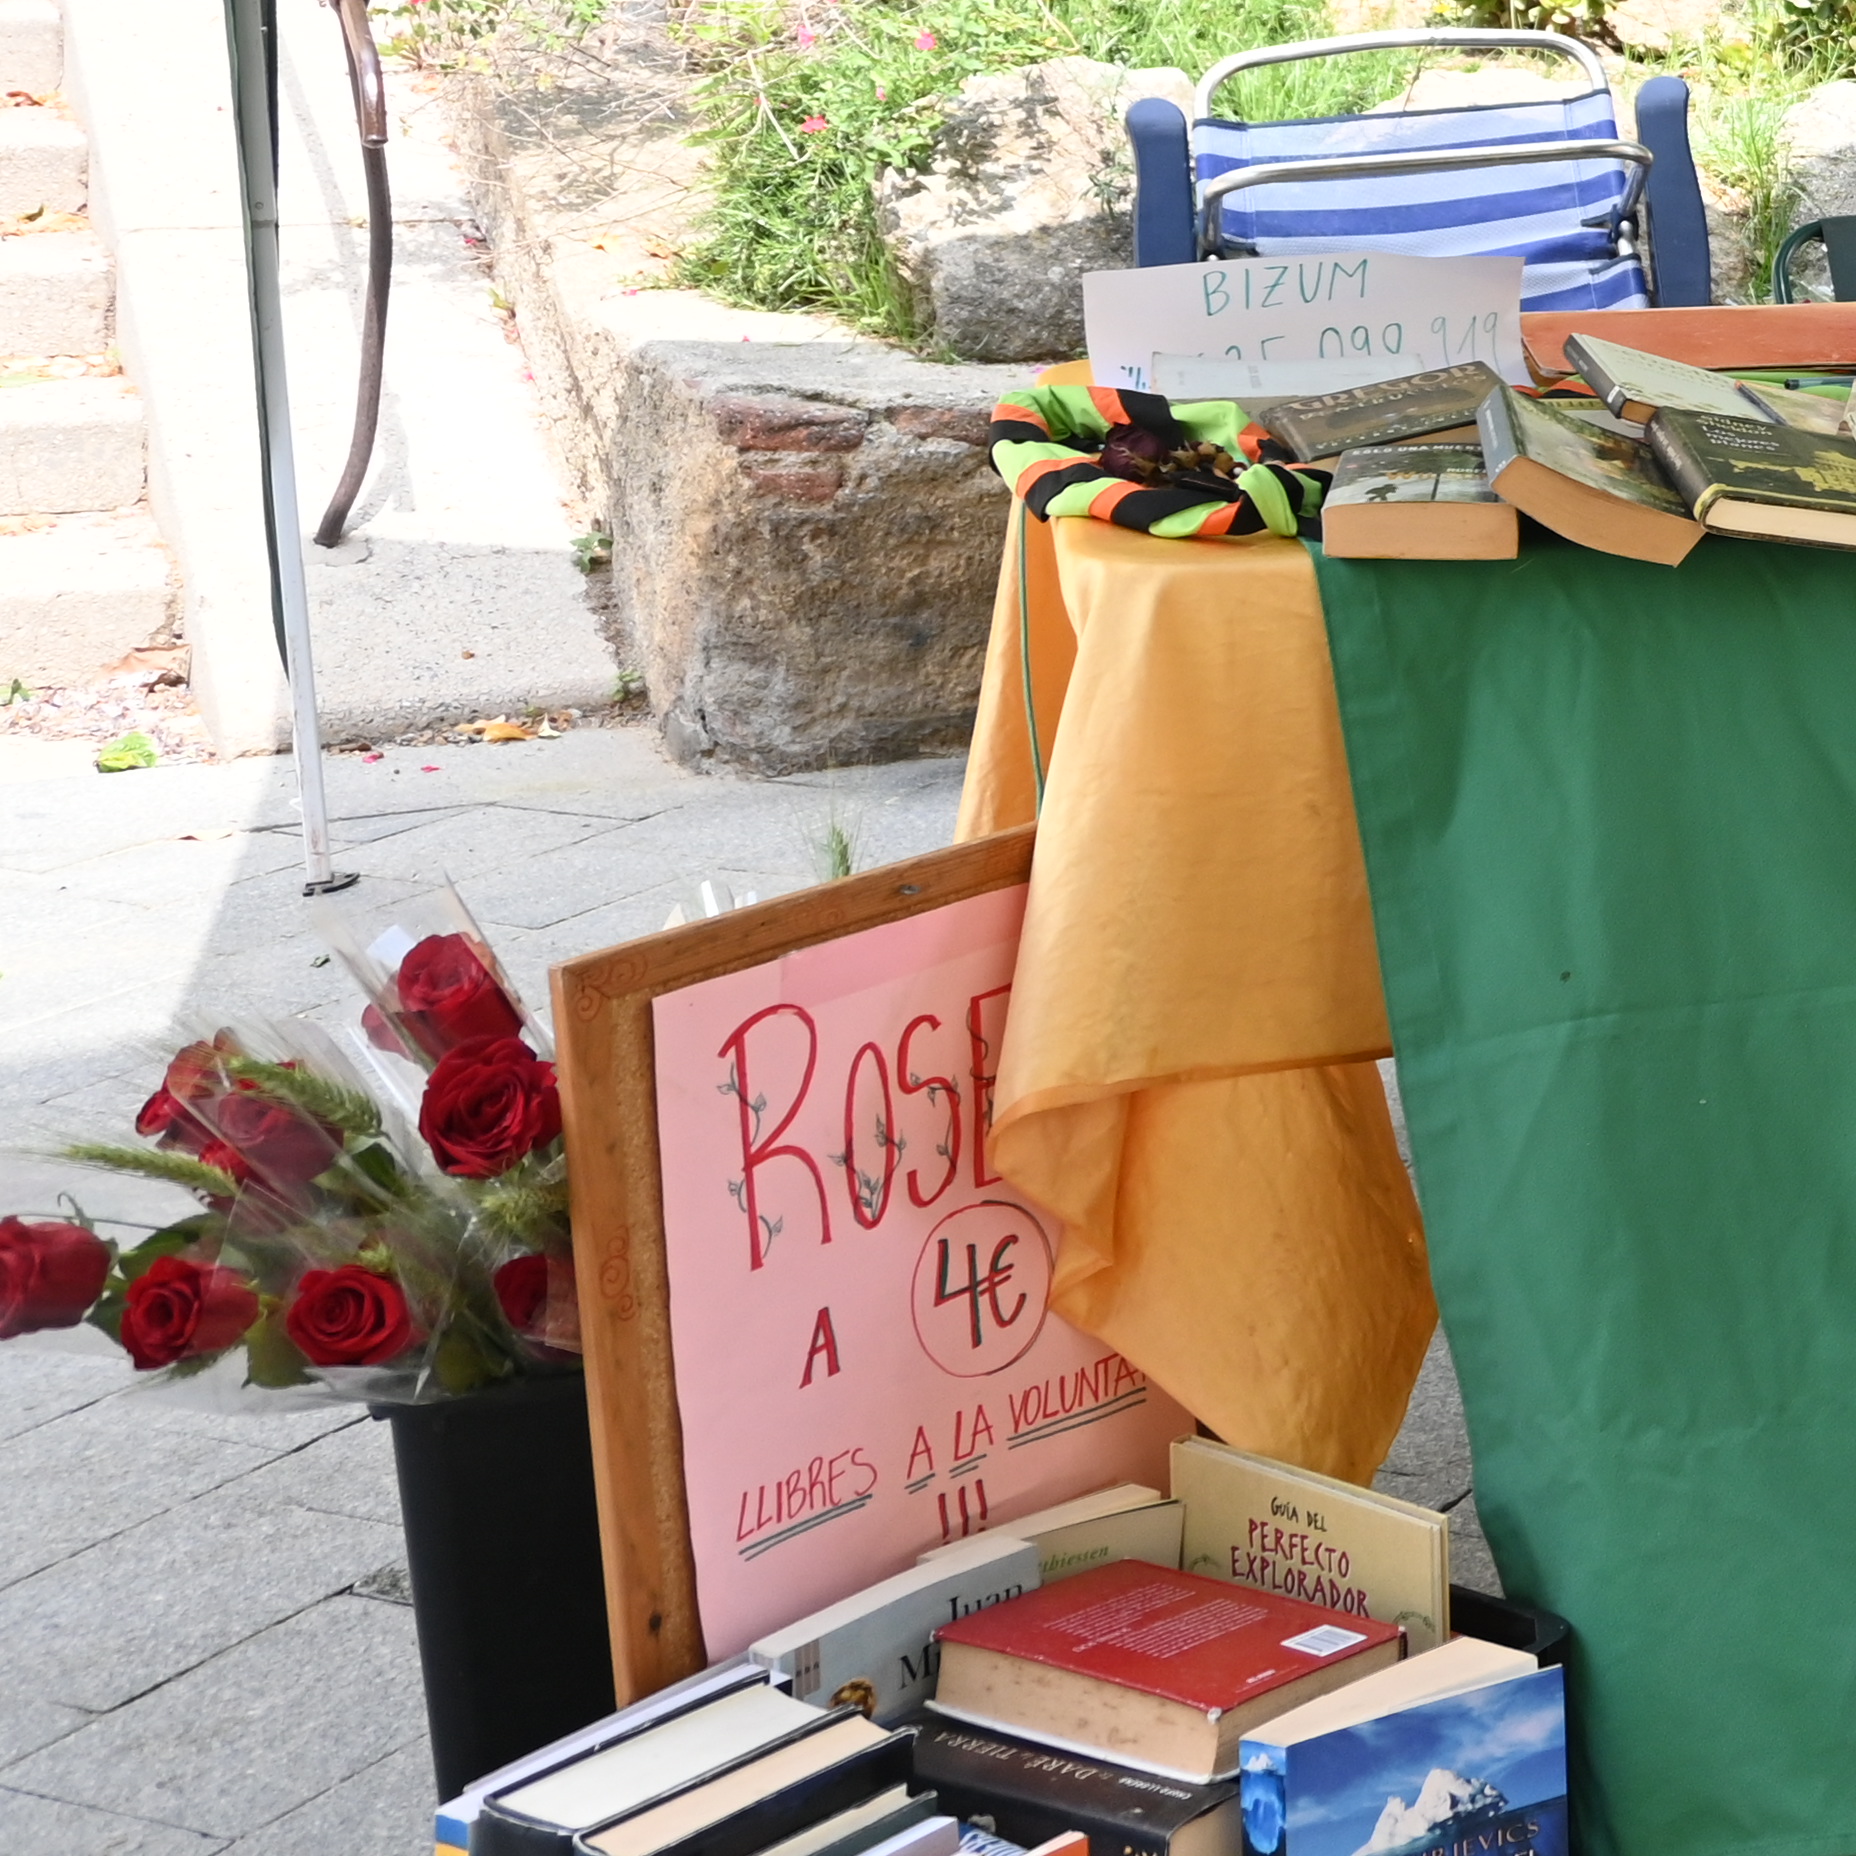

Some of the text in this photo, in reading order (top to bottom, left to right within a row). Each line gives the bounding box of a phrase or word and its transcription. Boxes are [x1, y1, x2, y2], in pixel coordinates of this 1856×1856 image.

[1202, 258, 1369, 317] BIZUM
[1289, 364, 1479, 411] GREGOR
[717, 982, 1012, 1272] ROSE
[800, 1234, 1027, 1389] A 4€
[736, 1350, 1147, 1542] LLIBRES A LA VOLUNTA
[1248, 1517, 1351, 1579] PERFECTO
[1306, 1510, 1328, 1533] DEL
[1038, 1545, 1110, 1574] thiessen
[1230, 1545, 1371, 1619] EXPLORADOR
[933, 1730, 1014, 1761] TIERRA
[1024, 1754, 1098, 1781] DARÉ
